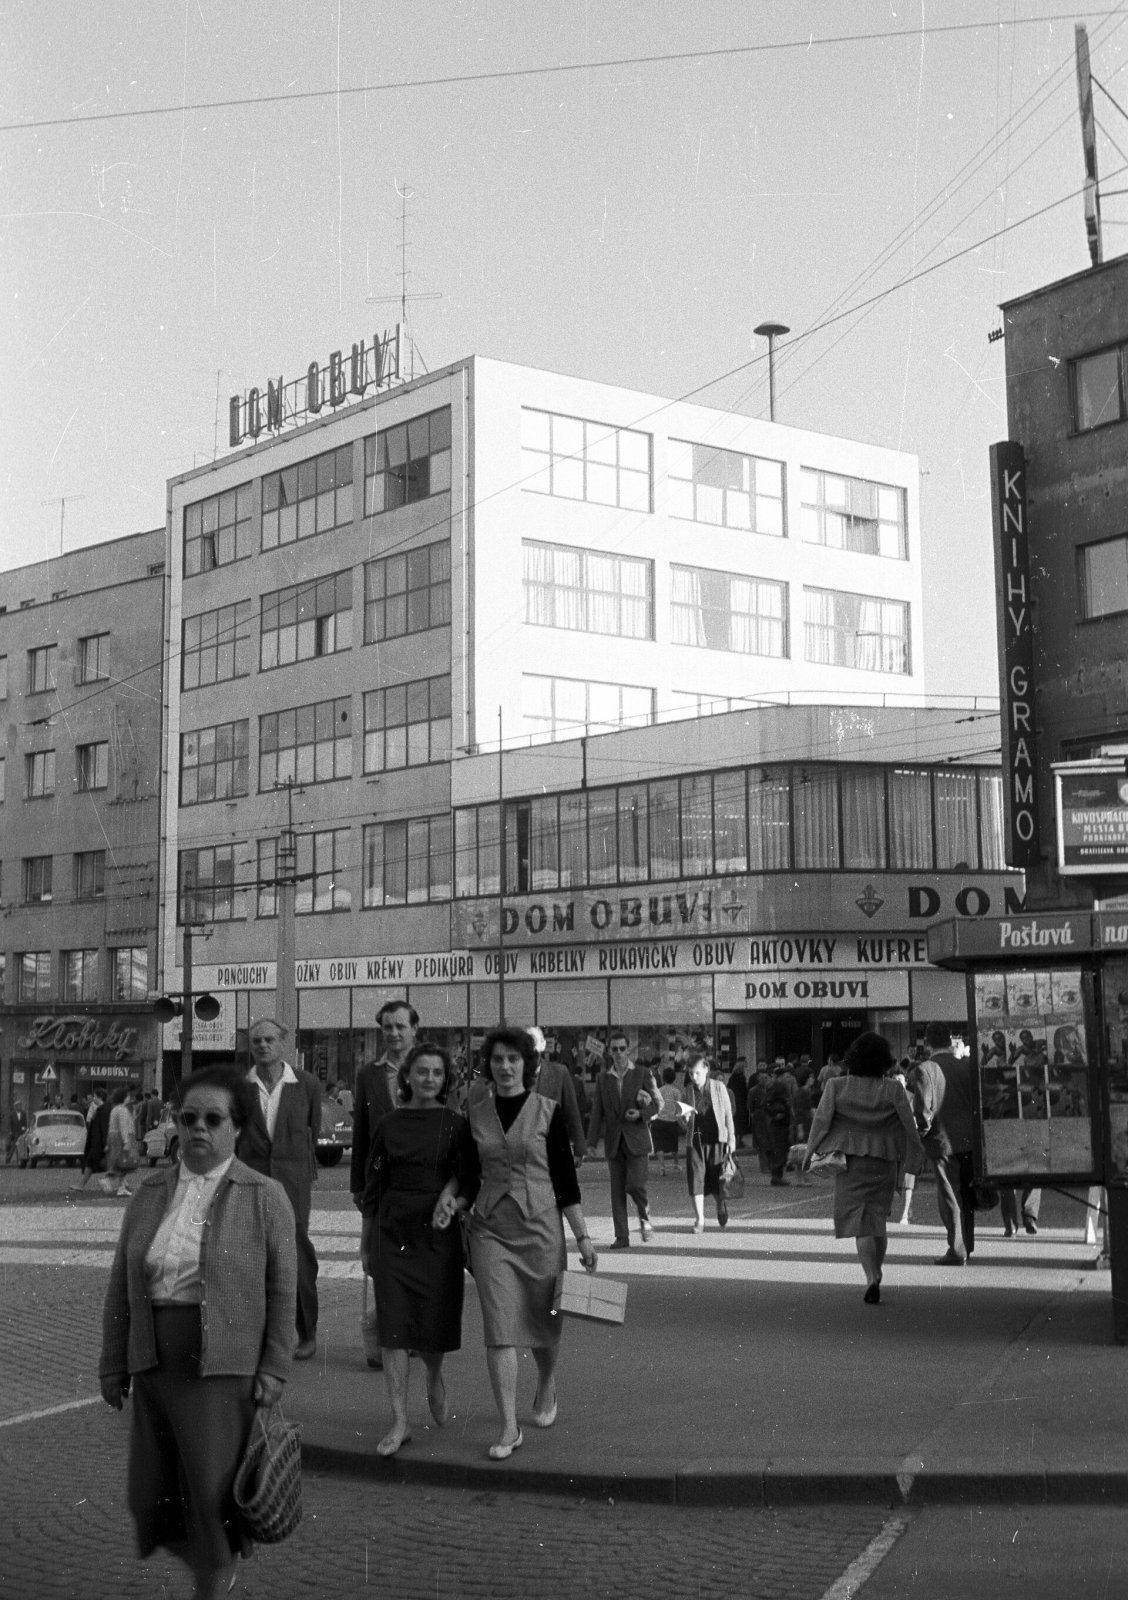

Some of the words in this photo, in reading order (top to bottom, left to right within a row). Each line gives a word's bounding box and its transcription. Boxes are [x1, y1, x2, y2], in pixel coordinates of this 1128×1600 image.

[1003, 469, 1026, 636] KNIHY
[1010, 665, 1034, 841] GRAMO
[501, 902, 575, 936] DOM
[590, 891, 712, 930] OBUVI
[1000, 921, 1075, 948] Poštová
[217, 964, 269, 986] PANČUCHY
[296, 961, 321, 983] OŽKY
[329, 961, 358, 981] OBUV
[367, 957, 404, 980] KRÉMY
[414, 953, 474, 978] PEDIKÚRA
[484, 952, 519, 975] OBUV
[530, 949, 587, 973] KABELKY
[599, 942, 679, 971] RUKAVIČKY
[692, 940, 736, 966] OBUV
[749, 938, 837, 965] AKTOVKY
[856, 937, 926, 964] KUFRE
[744, 982, 789, 1000] DOM
[793, 980, 870, 1000] OBUVI
